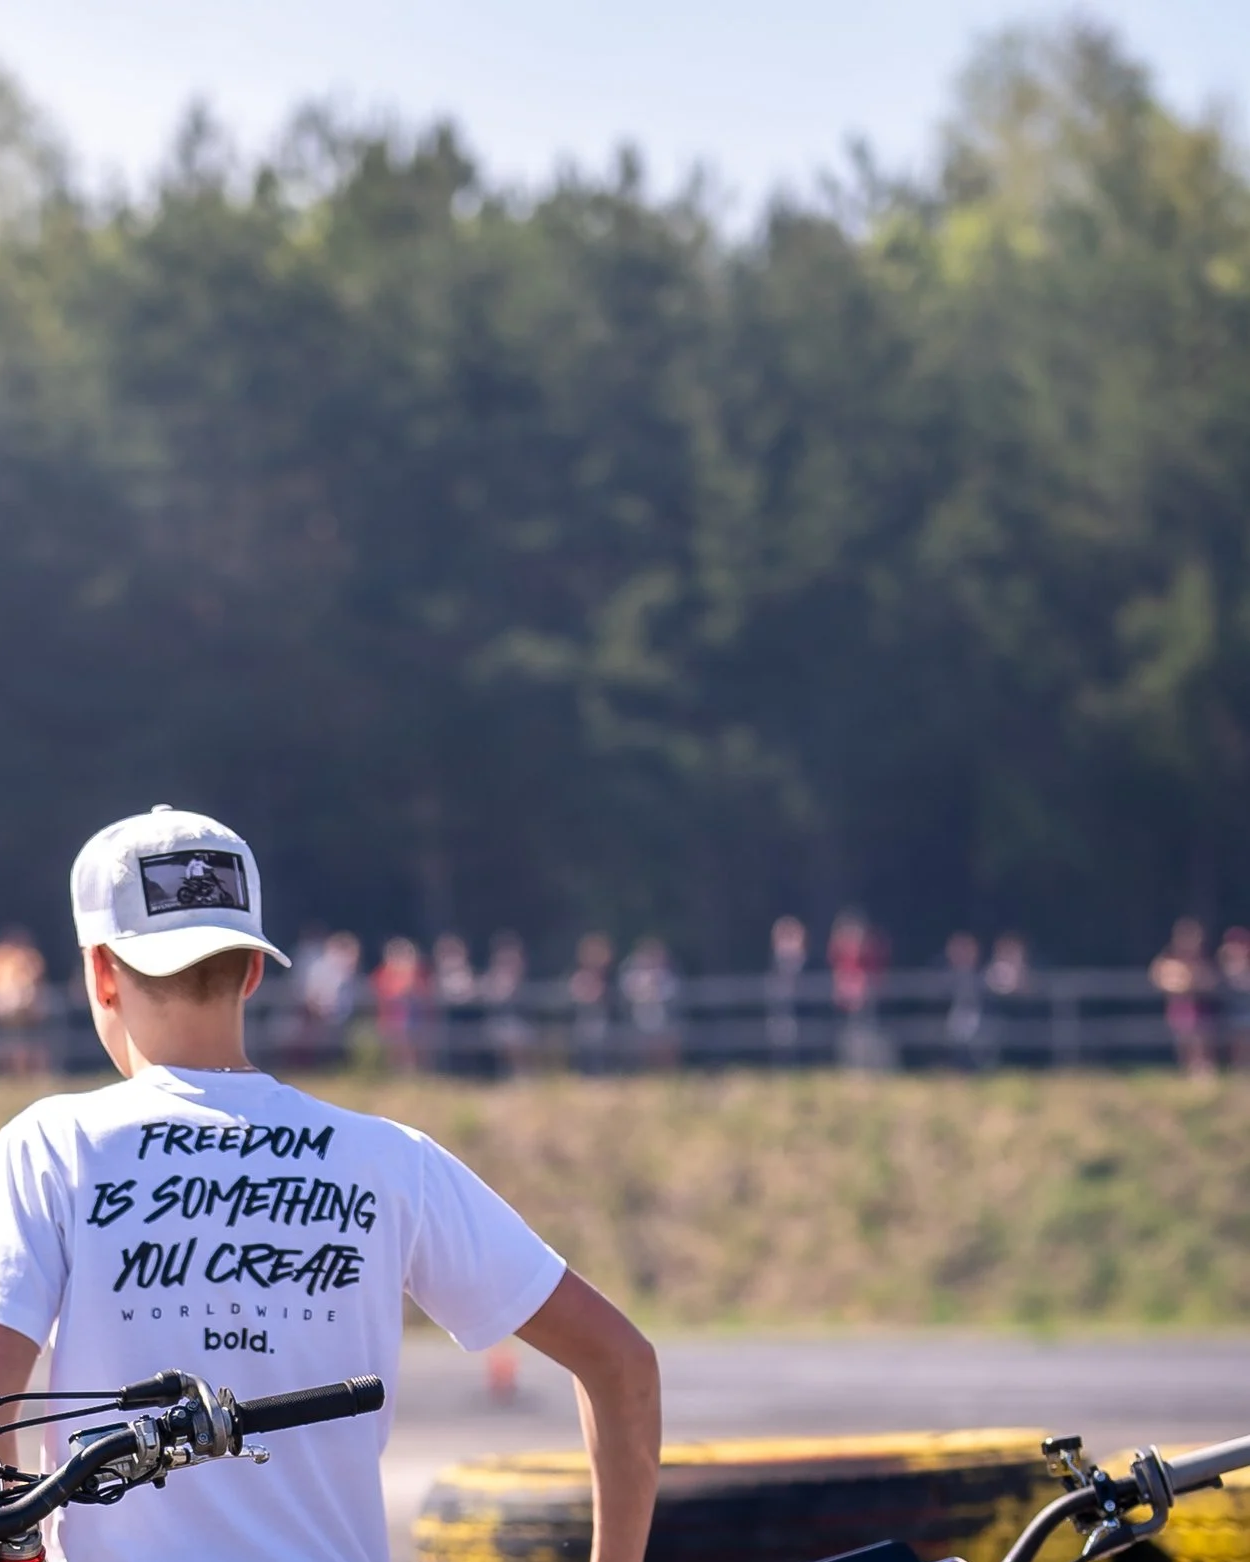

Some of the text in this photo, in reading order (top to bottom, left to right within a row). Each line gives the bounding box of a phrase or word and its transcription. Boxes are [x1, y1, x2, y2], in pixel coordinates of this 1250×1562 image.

[137, 1121, 335, 1161] FREEDOM
[86, 1174, 377, 1234] IS SOMETHING
[112, 1236, 366, 1297] YOU CREATE
[120, 1301, 338, 1323] WORLDWIDE
[203, 1327, 276, 1355] bold.
